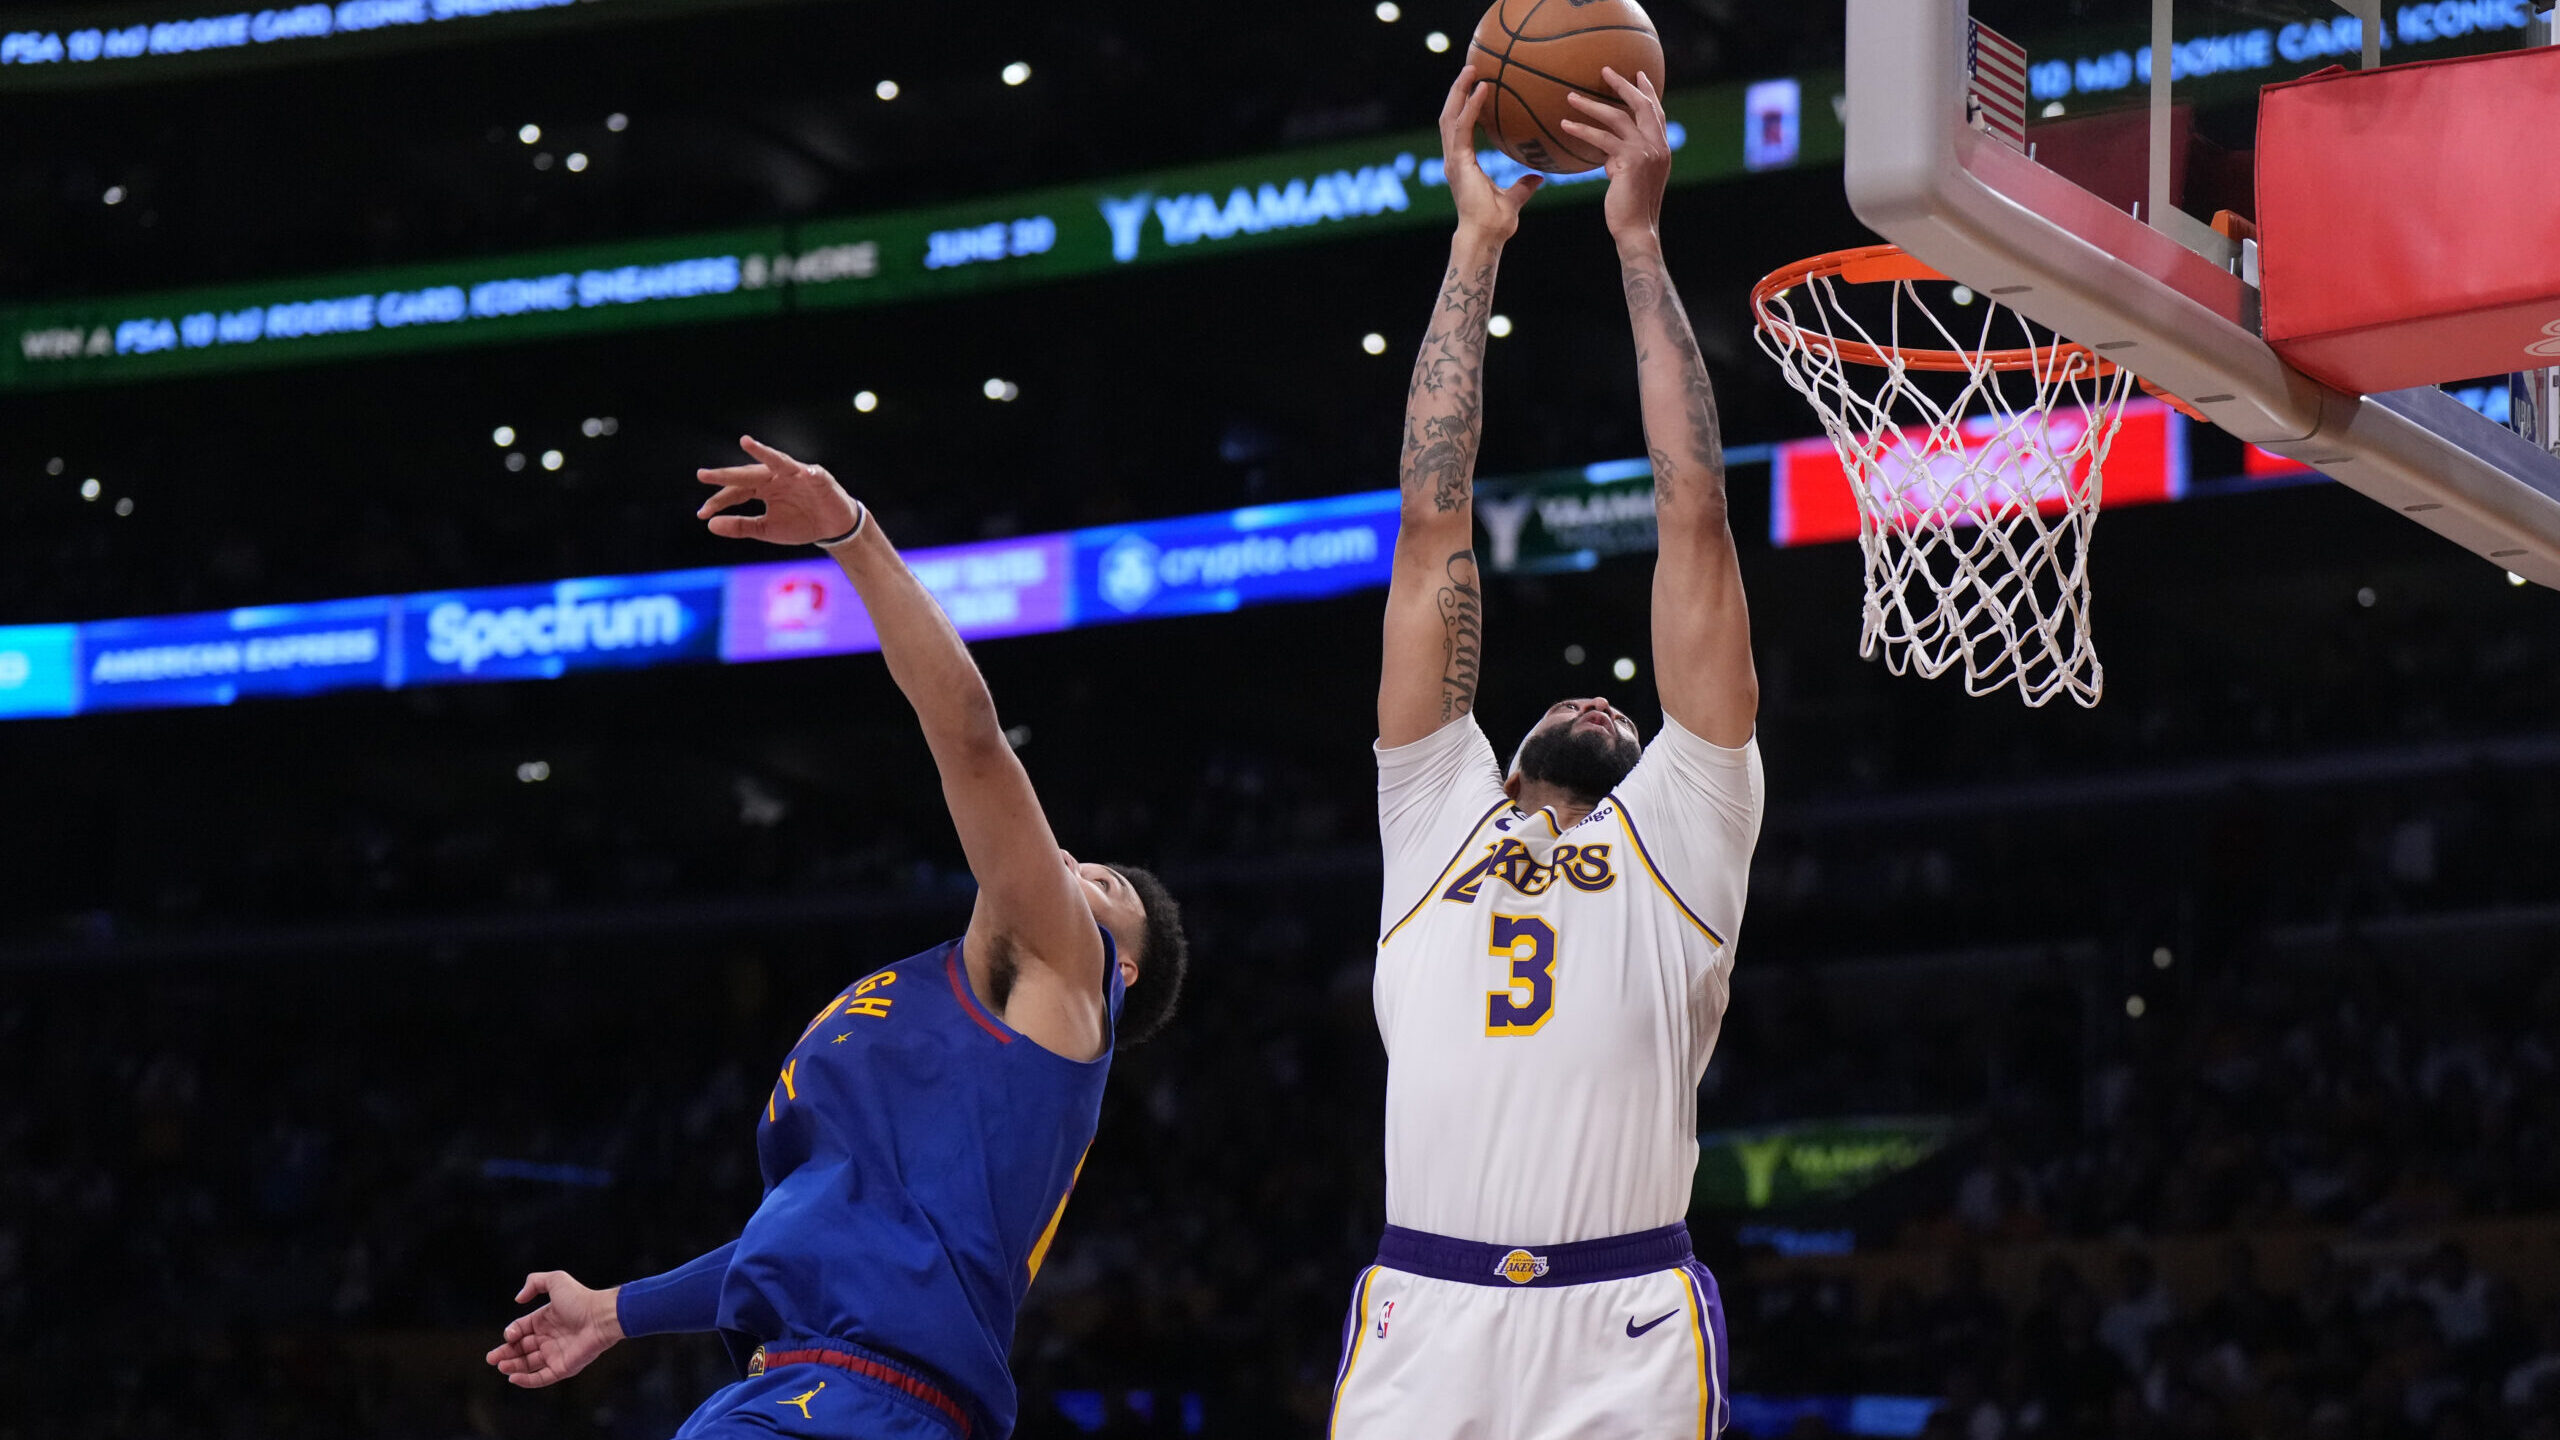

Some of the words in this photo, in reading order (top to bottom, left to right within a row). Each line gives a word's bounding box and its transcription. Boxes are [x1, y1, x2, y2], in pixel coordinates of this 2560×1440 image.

[85, 325, 113, 357] A
[264, 294, 376, 338] ROOKIE
[576, 255, 740, 307] SNEAKERS
[1159, 525, 1378, 586] crypto.com
[91, 640, 241, 684] AMERICAN
[244, 628, 379, 672] EXPRESS
[426, 590, 682, 673] Spectrum
[1485, 912, 1558, 1037] 3
[1498, 1257, 1546, 1276] LAKERS
